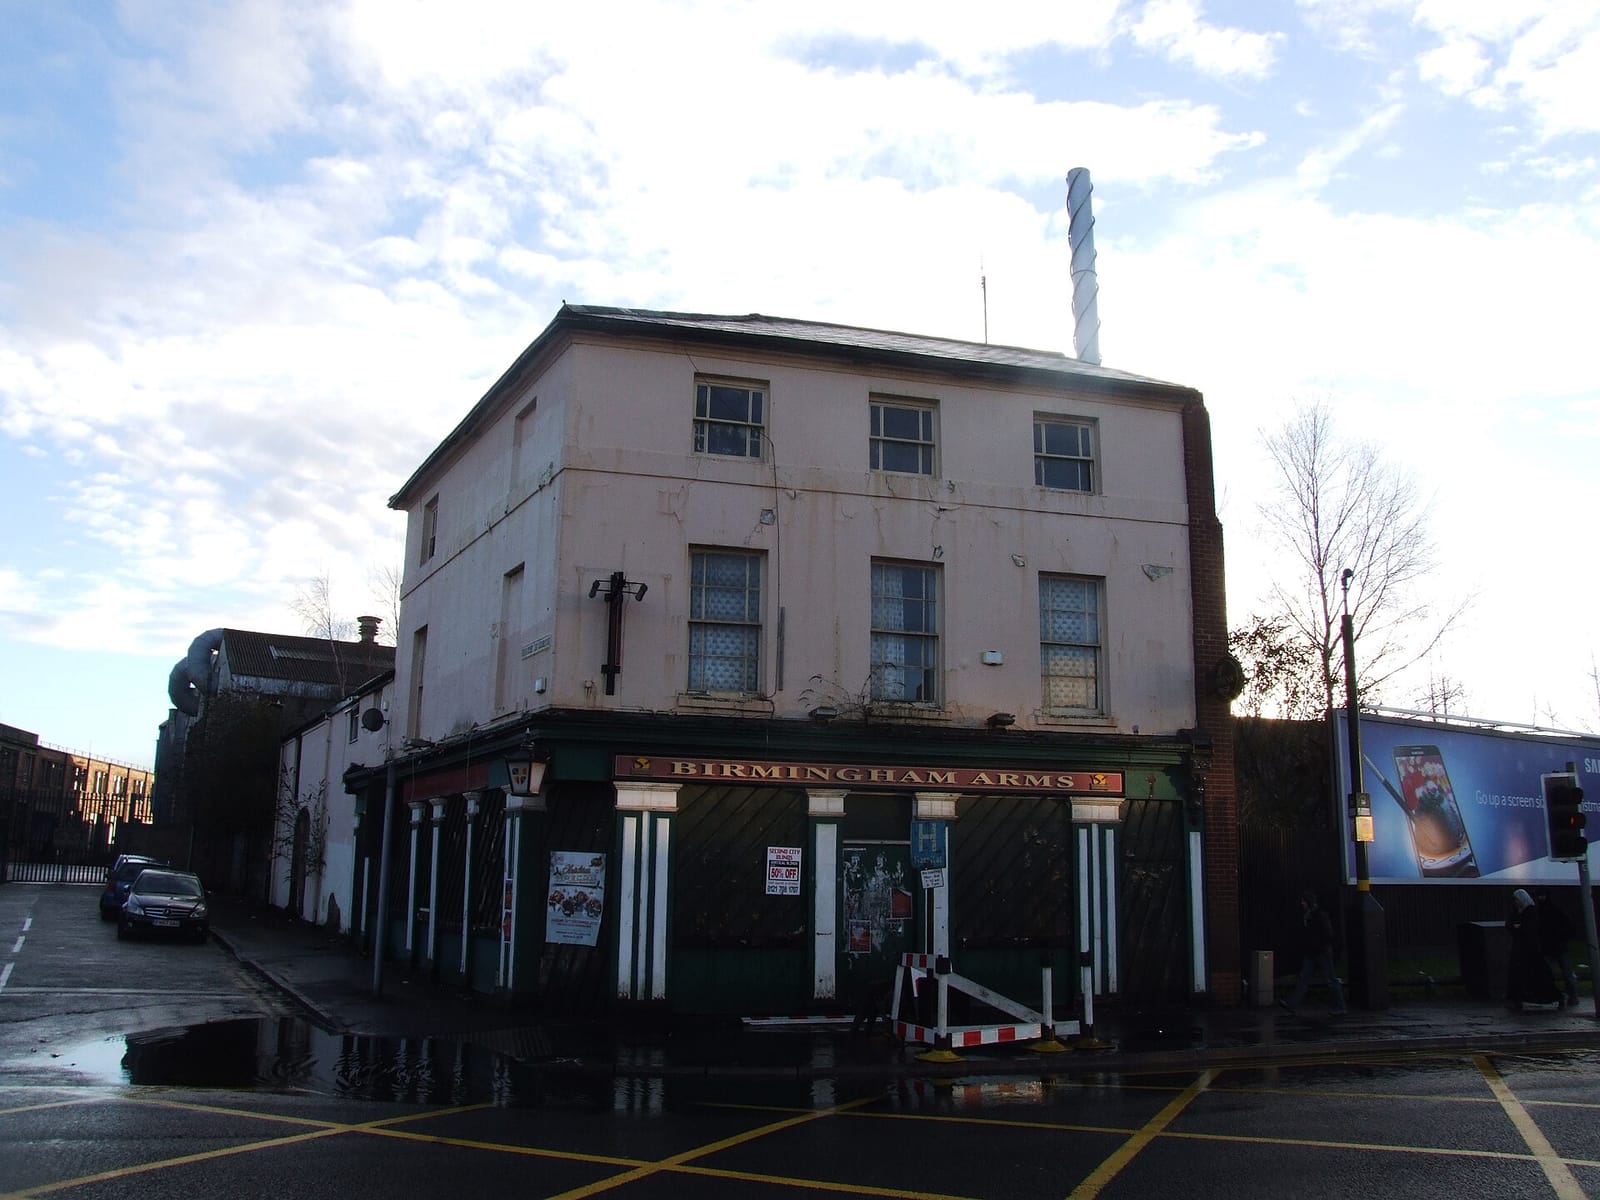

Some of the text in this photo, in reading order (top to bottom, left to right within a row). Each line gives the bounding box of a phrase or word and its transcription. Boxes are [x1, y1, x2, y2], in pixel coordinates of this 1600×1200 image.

[671, 761, 1075, 788] BIRMINGHAM ARMS
[1475, 790, 1488, 805] Go
[1488, 794, 1500, 808] up
[1501, 796, 1507, 805] a
[1507, 795, 1535, 808] screen
[919, 823, 937, 852] H
[771, 868, 797, 878] 50% OFF
